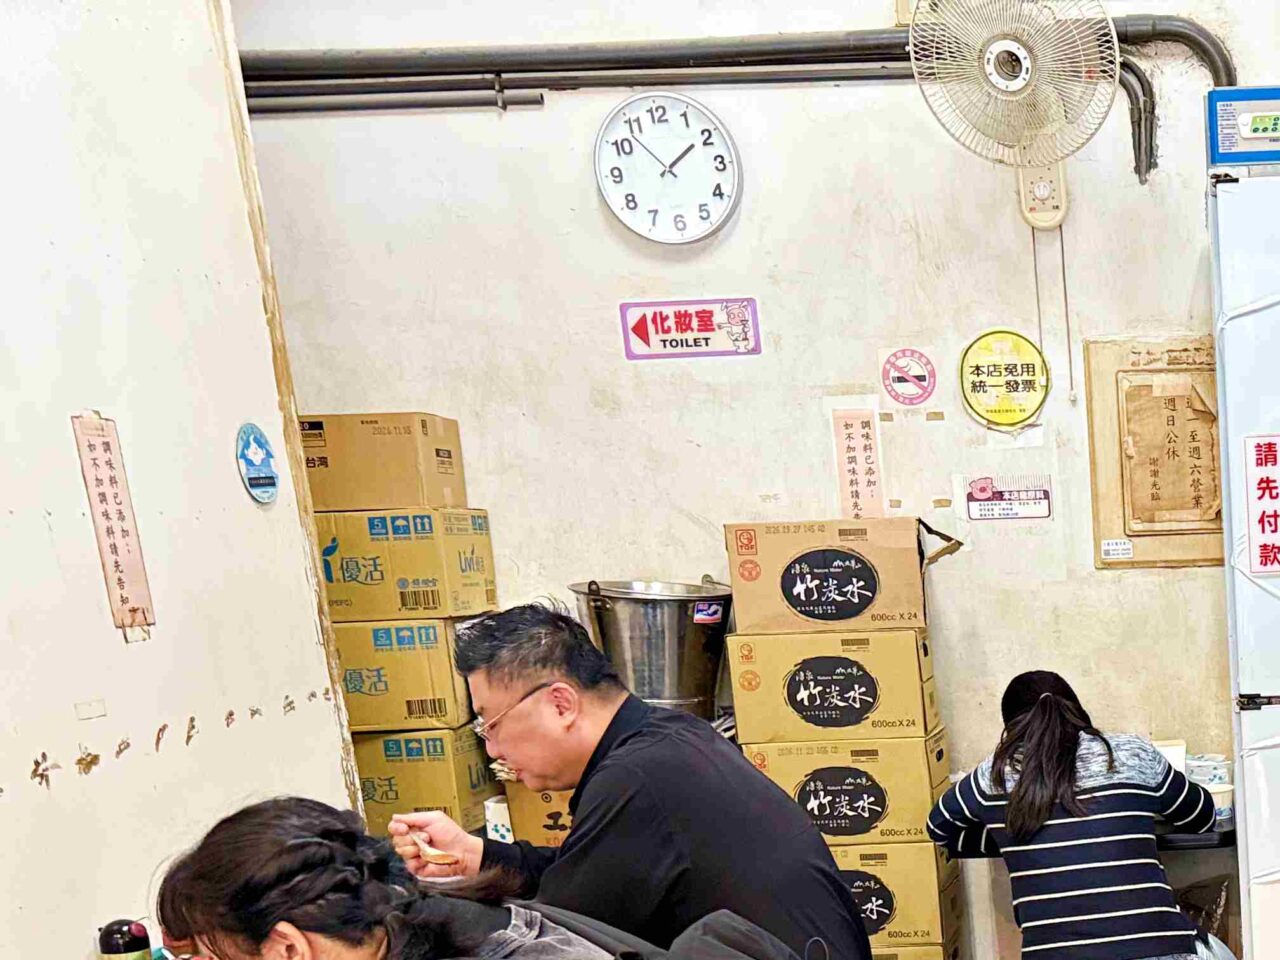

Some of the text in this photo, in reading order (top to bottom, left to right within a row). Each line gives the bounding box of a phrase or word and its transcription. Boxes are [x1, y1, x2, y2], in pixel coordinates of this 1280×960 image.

[646, 105, 668, 124] 12
[680, 111, 690, 128] 1
[624, 117, 642, 134] 11
[701, 129, 714, 146] 2
[611, 138, 633, 156] 10
[714, 155, 727, 172] 3
[610, 167, 623, 184] 9
[713, 183, 724, 200] 4
[625, 193, 638, 211] 8
[648, 209, 659, 226] 7
[698, 203, 710, 220] 5
[674, 214, 687, 231] 6
[651, 309, 716, 335] 化妝室
[660, 337, 711, 349] TOILET
[969, 363, 1036, 377] 本店免用
[970, 379, 1037, 393] 統一發票
[1164, 397, 1180, 461] 週日公休
[1149, 457, 1161, 502] 謝謝光臨
[87, 439, 130, 607] 如不加調味料請先告知
[374, 519, 382, 529] 5
[340, 555, 385, 585] 優活
[792, 574, 873, 604] 竹炭水
[871, 612, 918, 622] 600cc X 24
[377, 631, 387, 641] 5
[343, 667, 389, 696] 優活
[796, 682, 874, 708] 竹炭水
[871, 719, 916, 728] 600cc X 24
[807, 791, 882, 818] 竹炭水
[880, 828, 924, 837] 600cc X 24
[912, 930, 919, 938] X
[920, 930, 930, 938] 24
